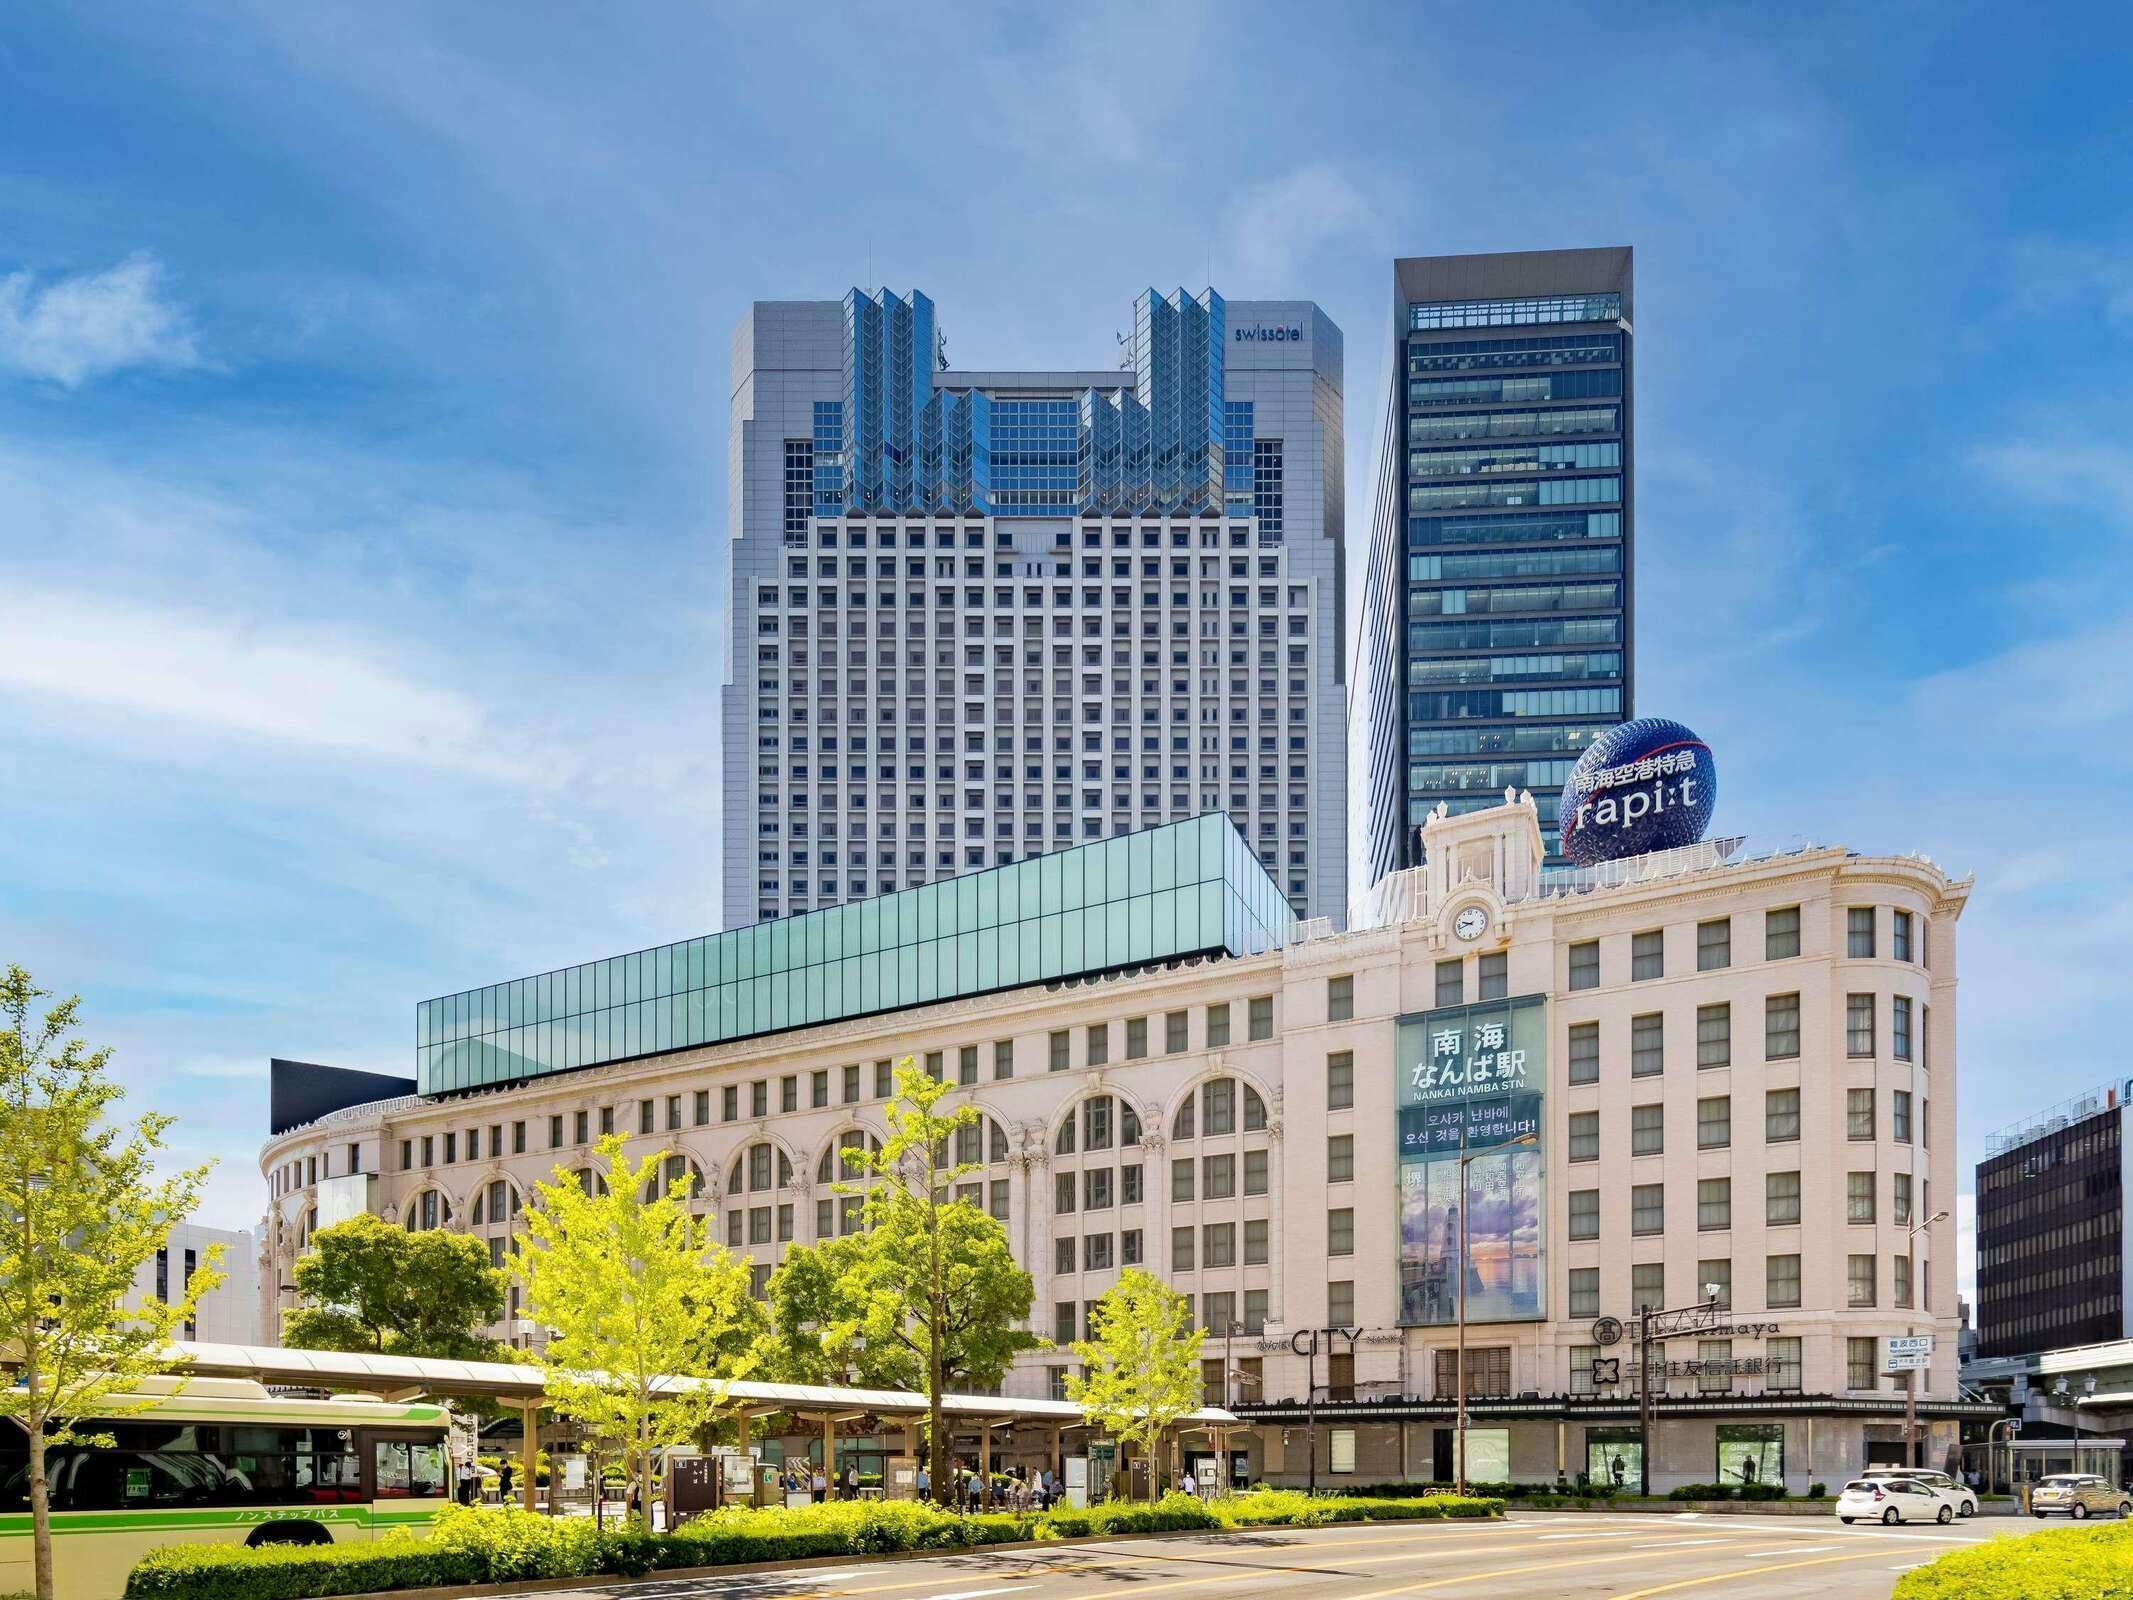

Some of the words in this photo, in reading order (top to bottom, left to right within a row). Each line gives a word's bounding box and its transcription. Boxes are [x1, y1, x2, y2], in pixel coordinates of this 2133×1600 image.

[1575, 750, 1697, 793] 南海空港特急
[1411, 1049, 1527, 1089] なんば駅
[1413, 1087, 1456, 1101] NANKAI
[1457, 1082, 1499, 1096] NAMBA
[1427, 1111, 1465, 1126] 오사카
[1471, 1105, 1509, 1122] 난바에
[1404, 1130, 1430, 1145] 오신
[1435, 1127, 1460, 1142] 것을
[1466, 1119, 1536, 1138] 환영합니다!
[1291, 1327, 1364, 1356] CITY
[235, 1509, 339, 1521] ノンステップバス
